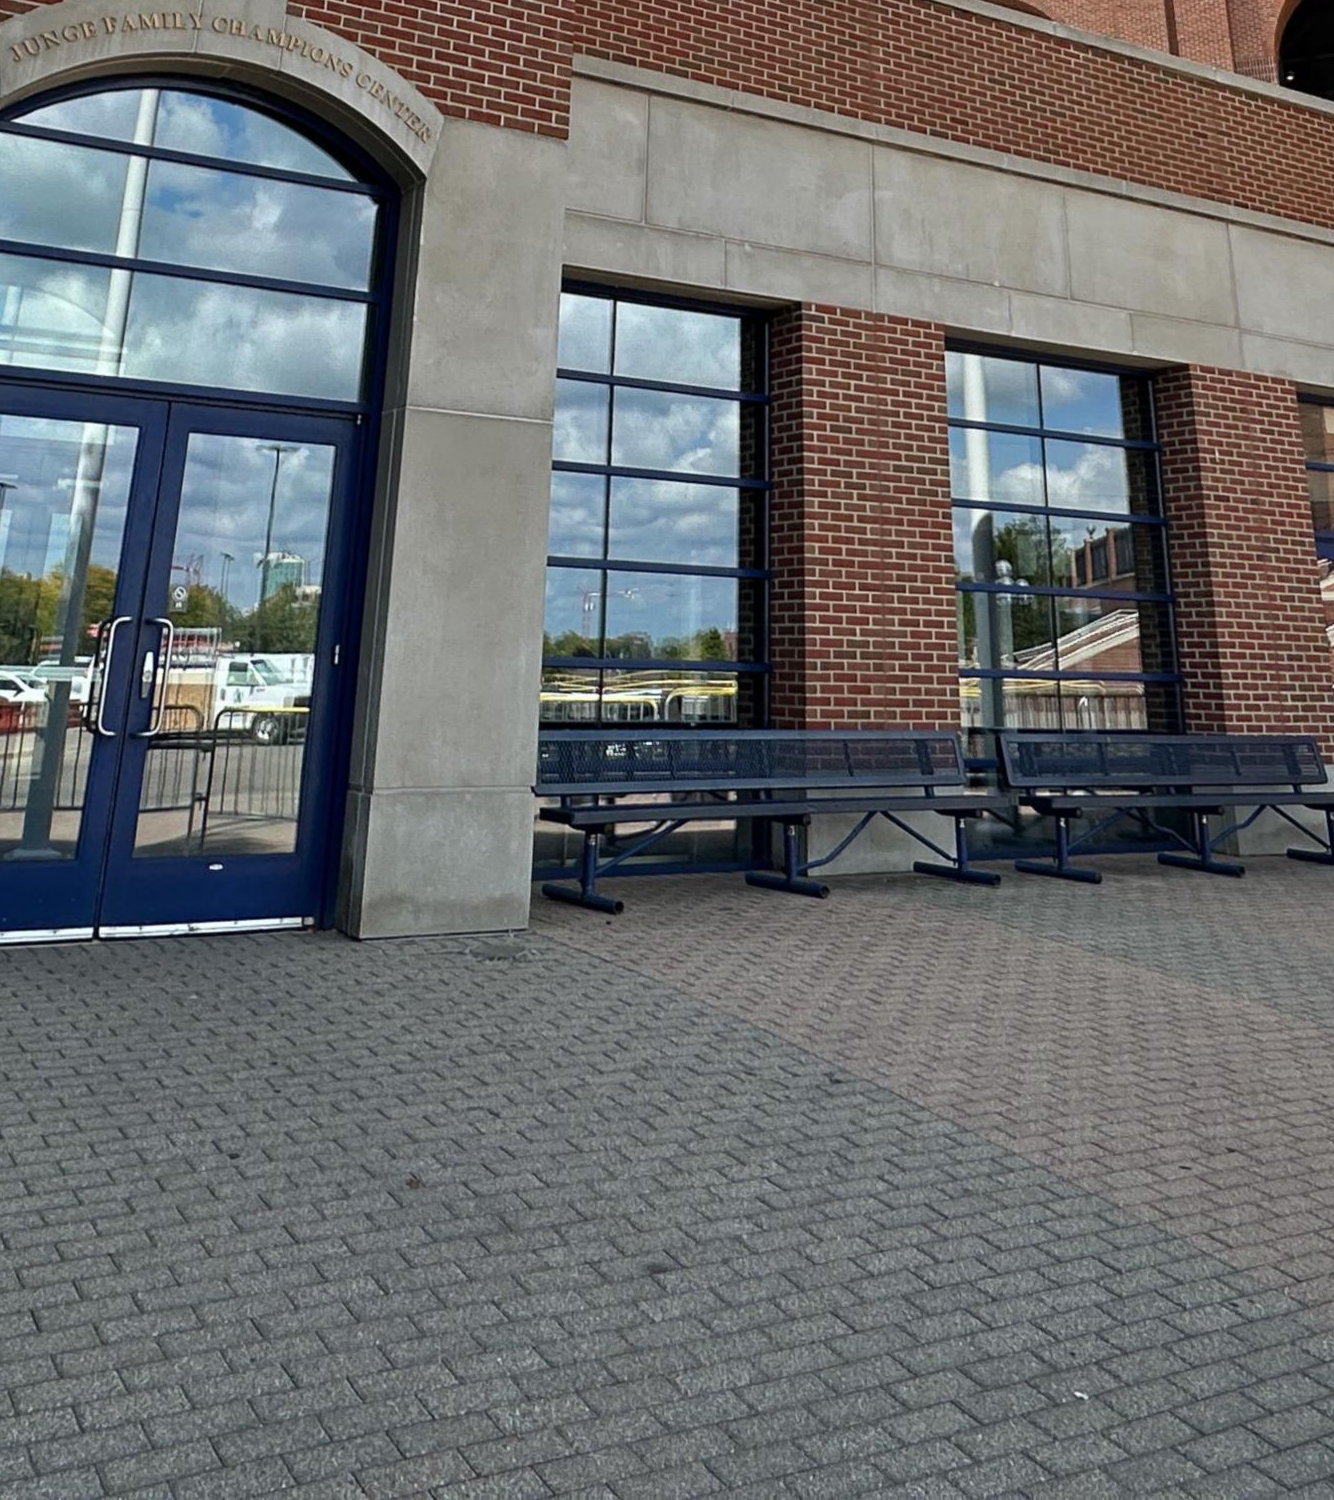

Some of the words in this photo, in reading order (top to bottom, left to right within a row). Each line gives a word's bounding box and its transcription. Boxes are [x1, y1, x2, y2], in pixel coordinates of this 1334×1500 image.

[9, 21, 97, 63] JUNGE
[102, 12, 204, 34] FAMILY
[212, 16, 354, 80] CHAMPIONS
[355, 72, 433, 144] CENTER
